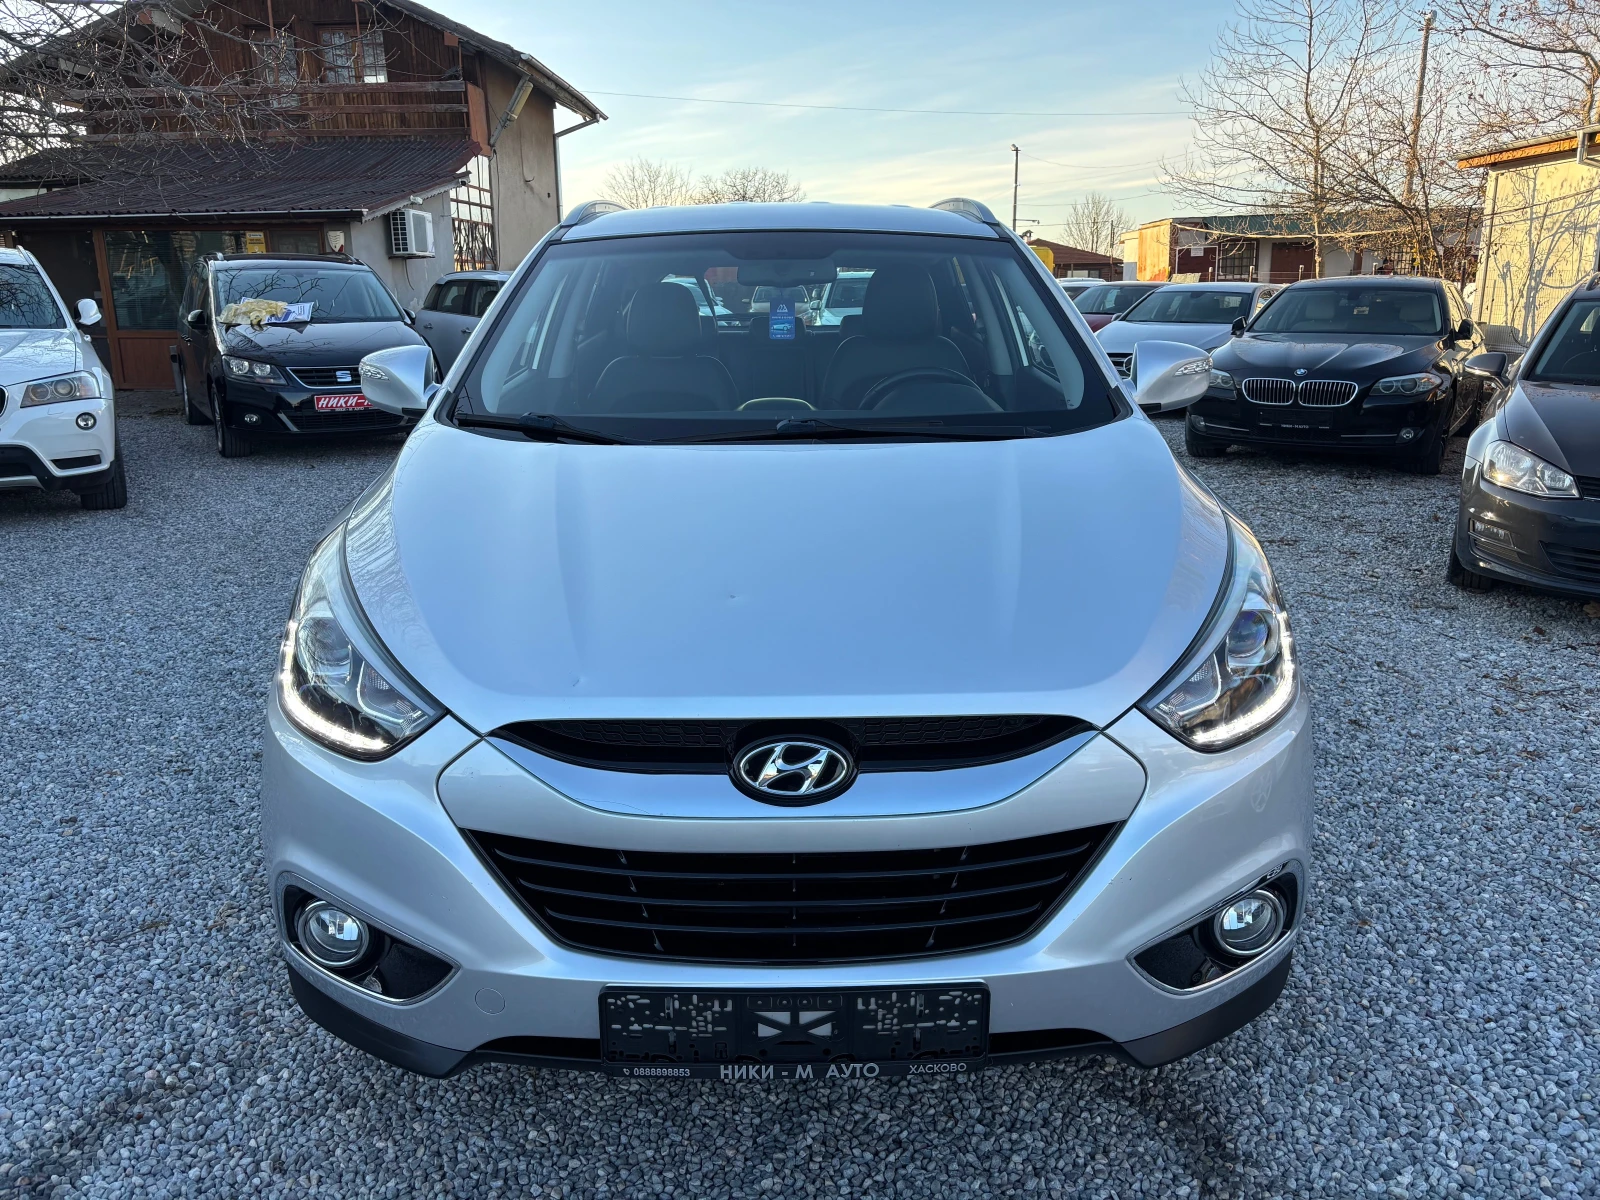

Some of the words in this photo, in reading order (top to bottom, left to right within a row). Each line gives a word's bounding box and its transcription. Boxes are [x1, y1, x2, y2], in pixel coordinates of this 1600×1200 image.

[633, 1067, 691, 1077] 0888898853
[720, 1065, 774, 1079] НИКИ
[795, 1064, 814, 1079] М
[826, 1062, 880, 1078] АУТО
[909, 1062, 967, 1074] ХАСКОВО
